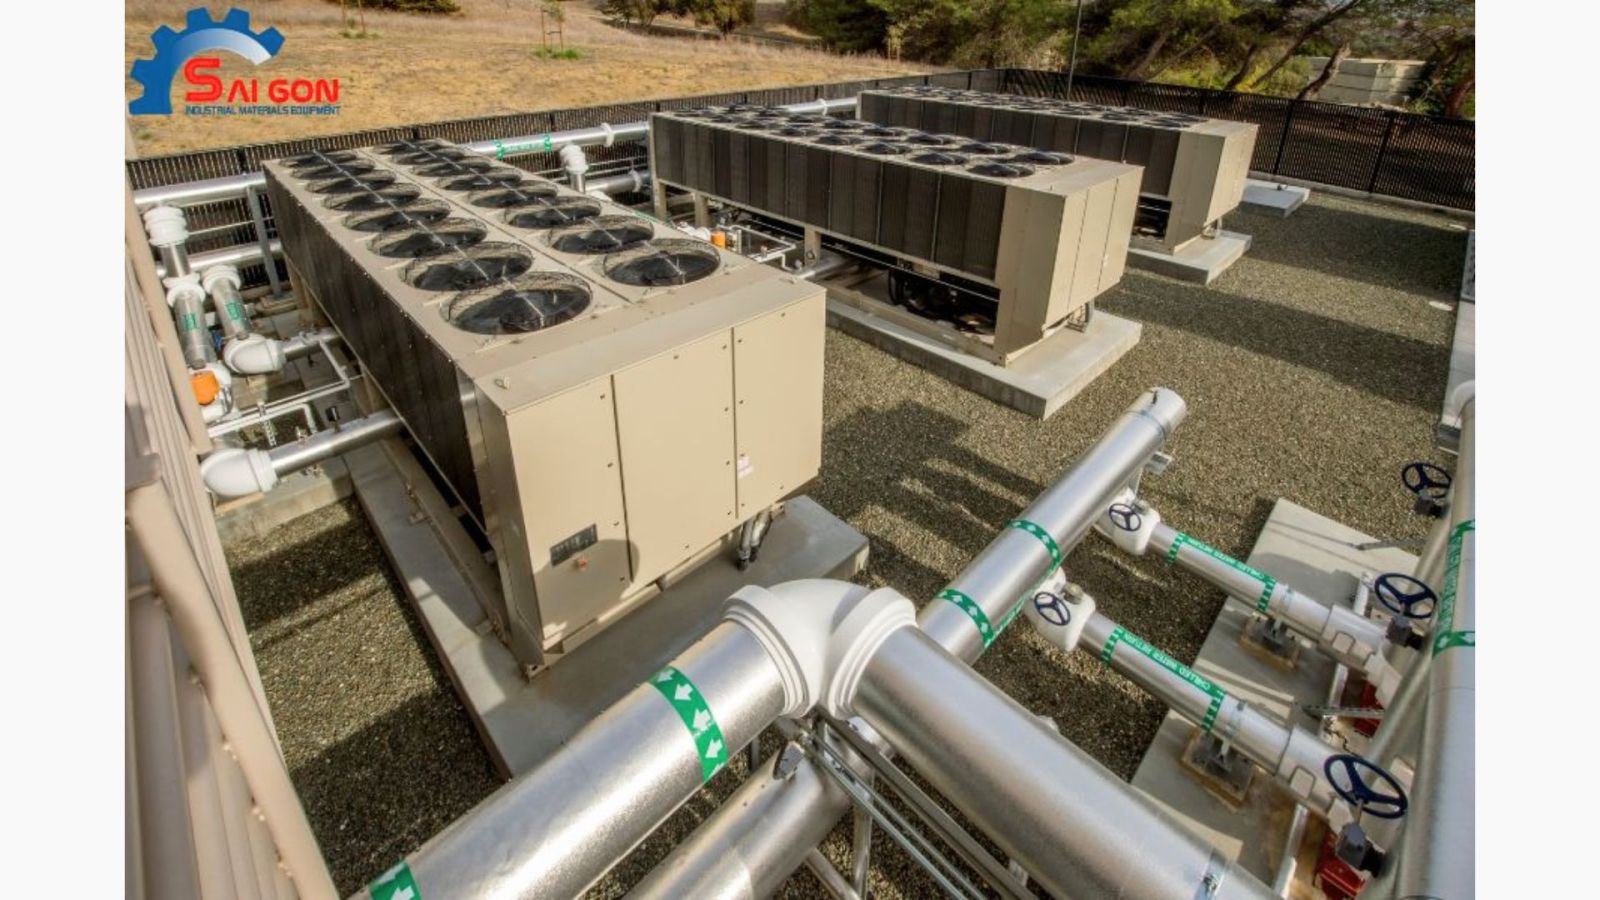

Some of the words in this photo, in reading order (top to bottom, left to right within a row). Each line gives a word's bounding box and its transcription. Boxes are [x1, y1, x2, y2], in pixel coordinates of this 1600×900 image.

[1122, 631, 1152, 654] RETURN
[1151, 649, 1178, 670] WATER
[1177, 665, 1211, 691] CHILLED
